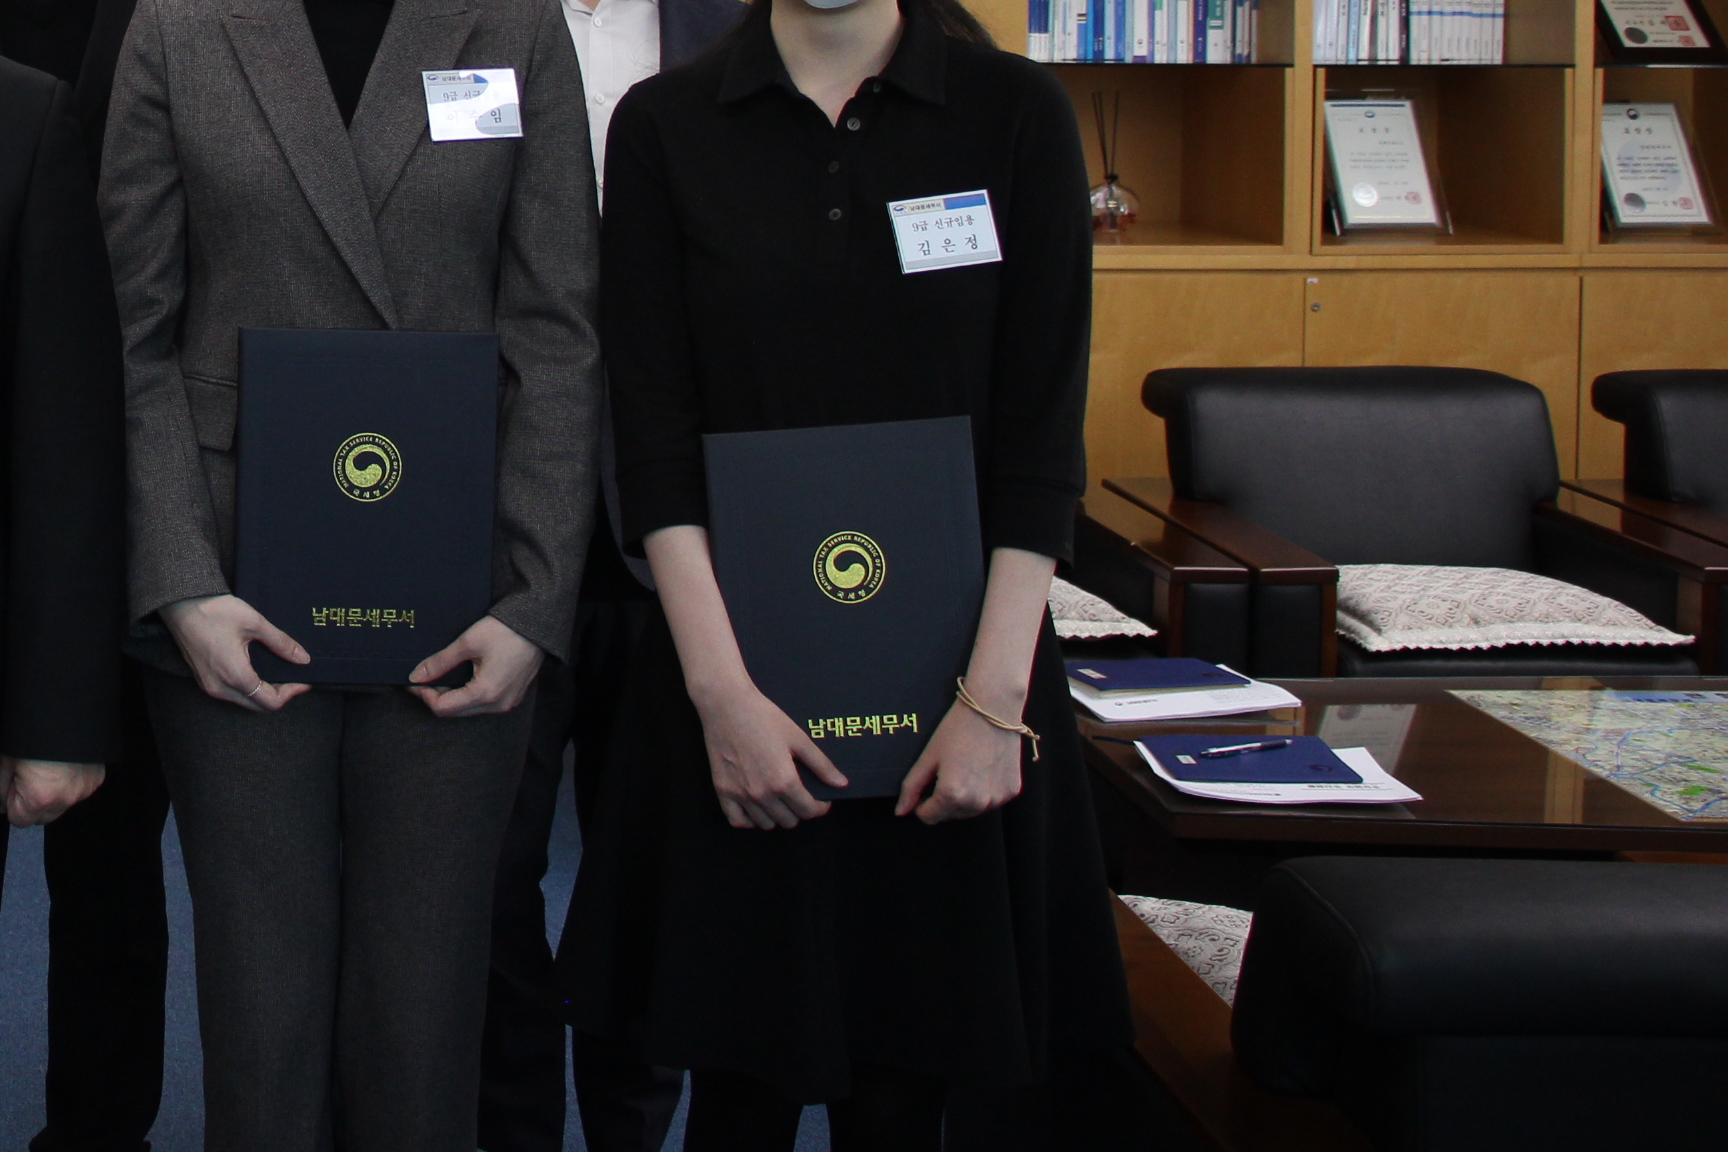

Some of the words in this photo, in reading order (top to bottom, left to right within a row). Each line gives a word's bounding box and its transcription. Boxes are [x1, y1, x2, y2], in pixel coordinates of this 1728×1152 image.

[443, 91, 458, 102] 9급
[912, 220, 929, 232] 9급
[934, 214, 975, 230] 신규임용
[349, 436, 373, 446] SERVICE
[375, 437, 396, 460] REPUBLIC
[340, 446, 349, 456] TAX
[337, 458, 349, 488] NATIONAL
[393, 461, 398, 469] OF
[384, 472, 397, 489] KOREA
[827, 535, 852, 547] SERVICE
[853, 535, 878, 557] REPUBLIC
[819, 547, 829, 558] TAX
[875, 558, 881, 567] OF
[817, 560, 832, 591] NATIONAL
[869, 569, 881, 588] KOREA
[312, 606, 415, 628] 남대문세무서
[808, 712, 918, 739] 남대문세무서
